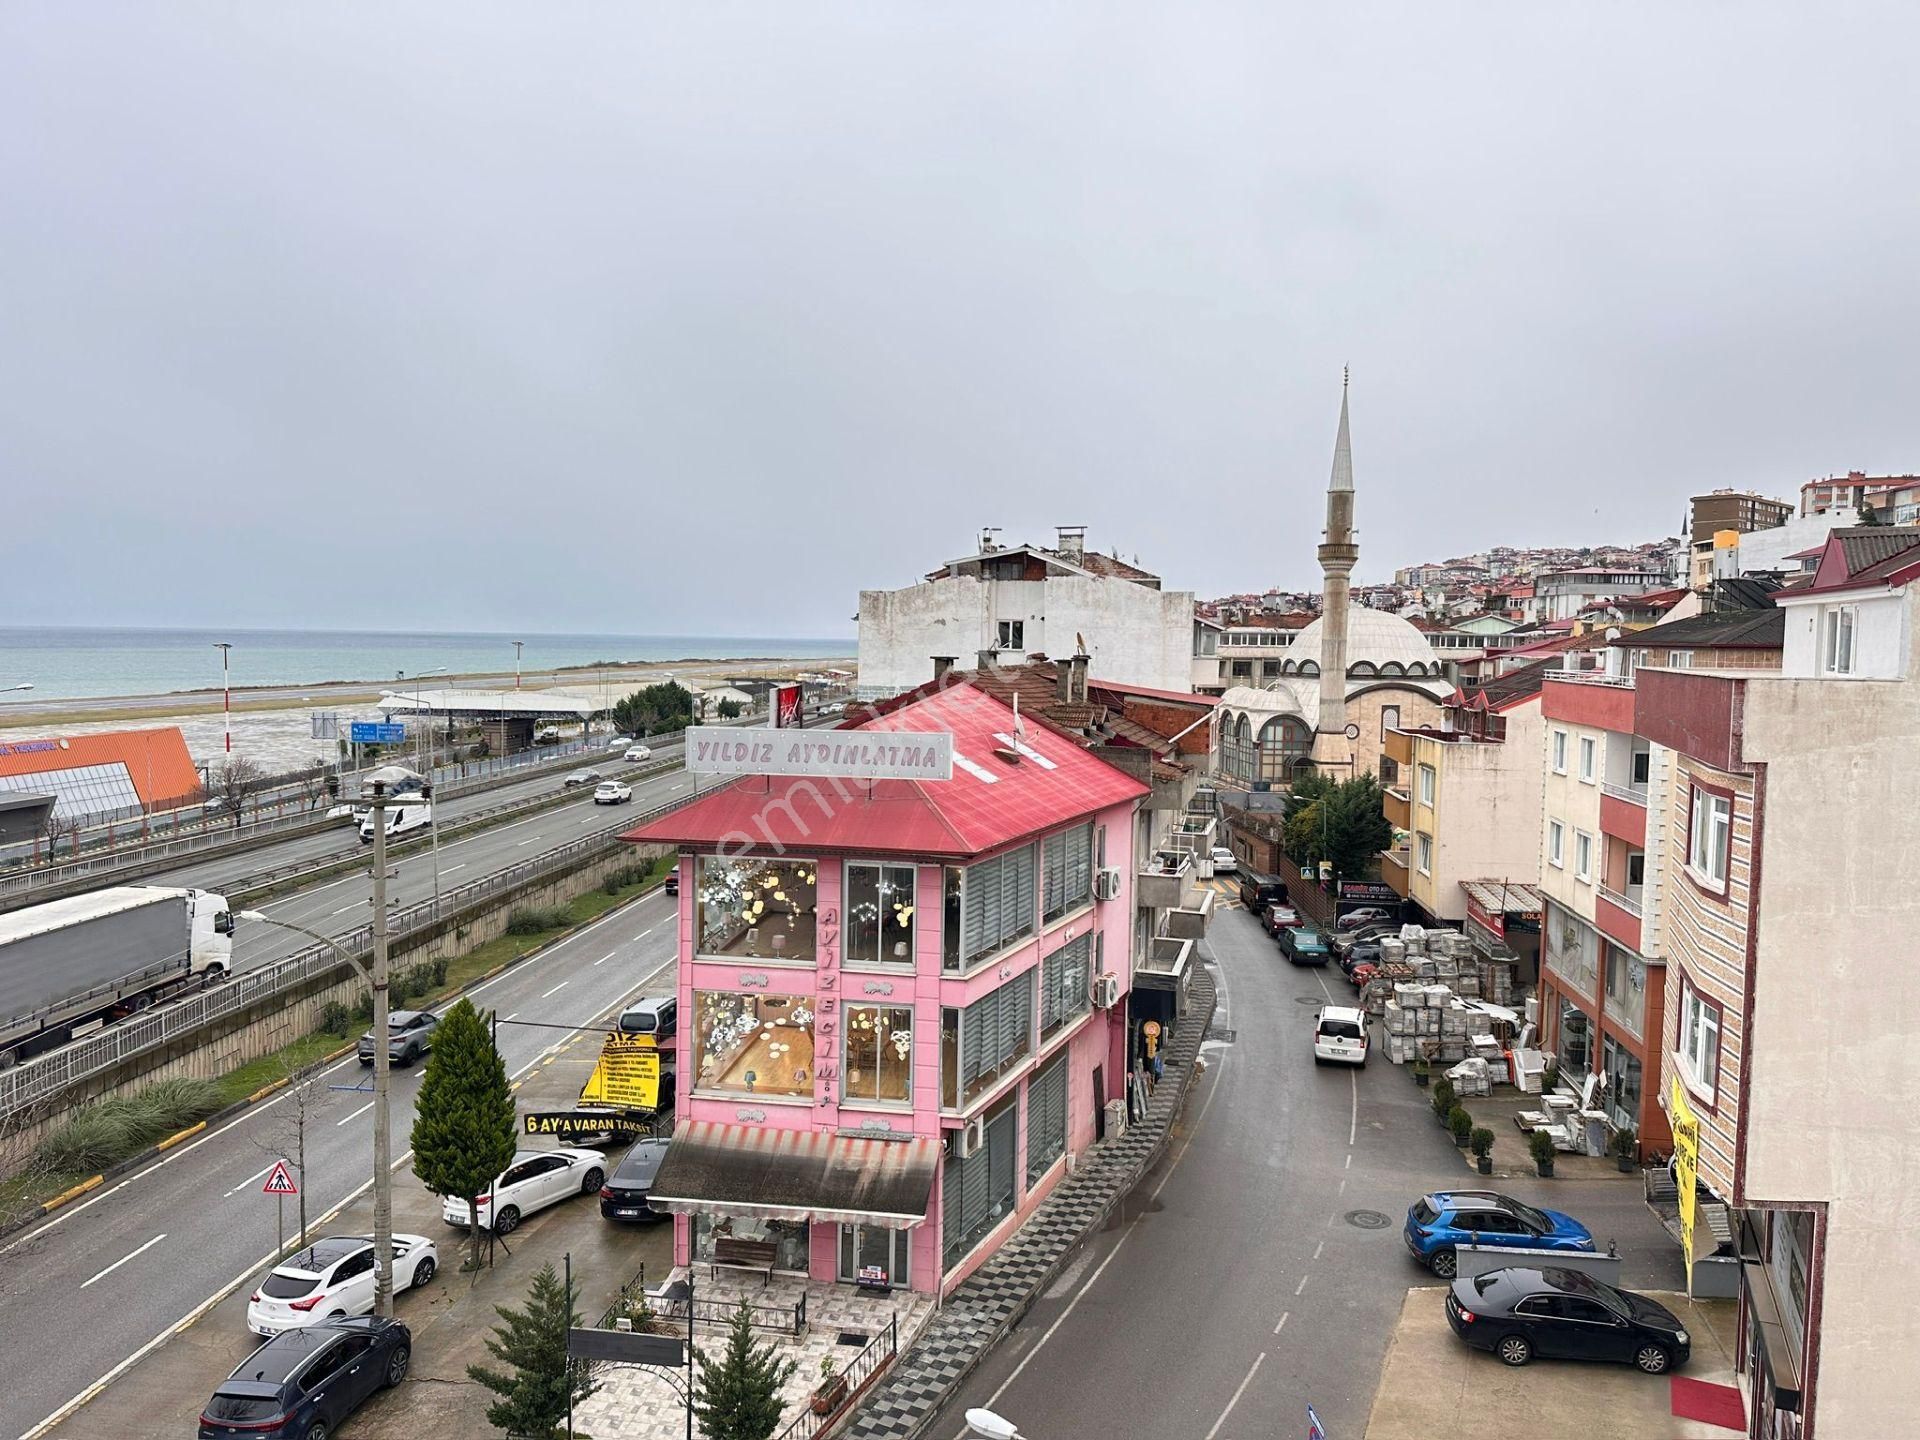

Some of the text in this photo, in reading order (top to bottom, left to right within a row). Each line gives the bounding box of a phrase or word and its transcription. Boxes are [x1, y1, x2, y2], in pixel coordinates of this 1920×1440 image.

[697, 741, 937, 768] YILDIZ AYDINLATMA
[526, 1116, 538, 1133] 6
[573, 1118, 614, 1132] VARAN
[616, 1119, 651, 1134] TAKSİT
